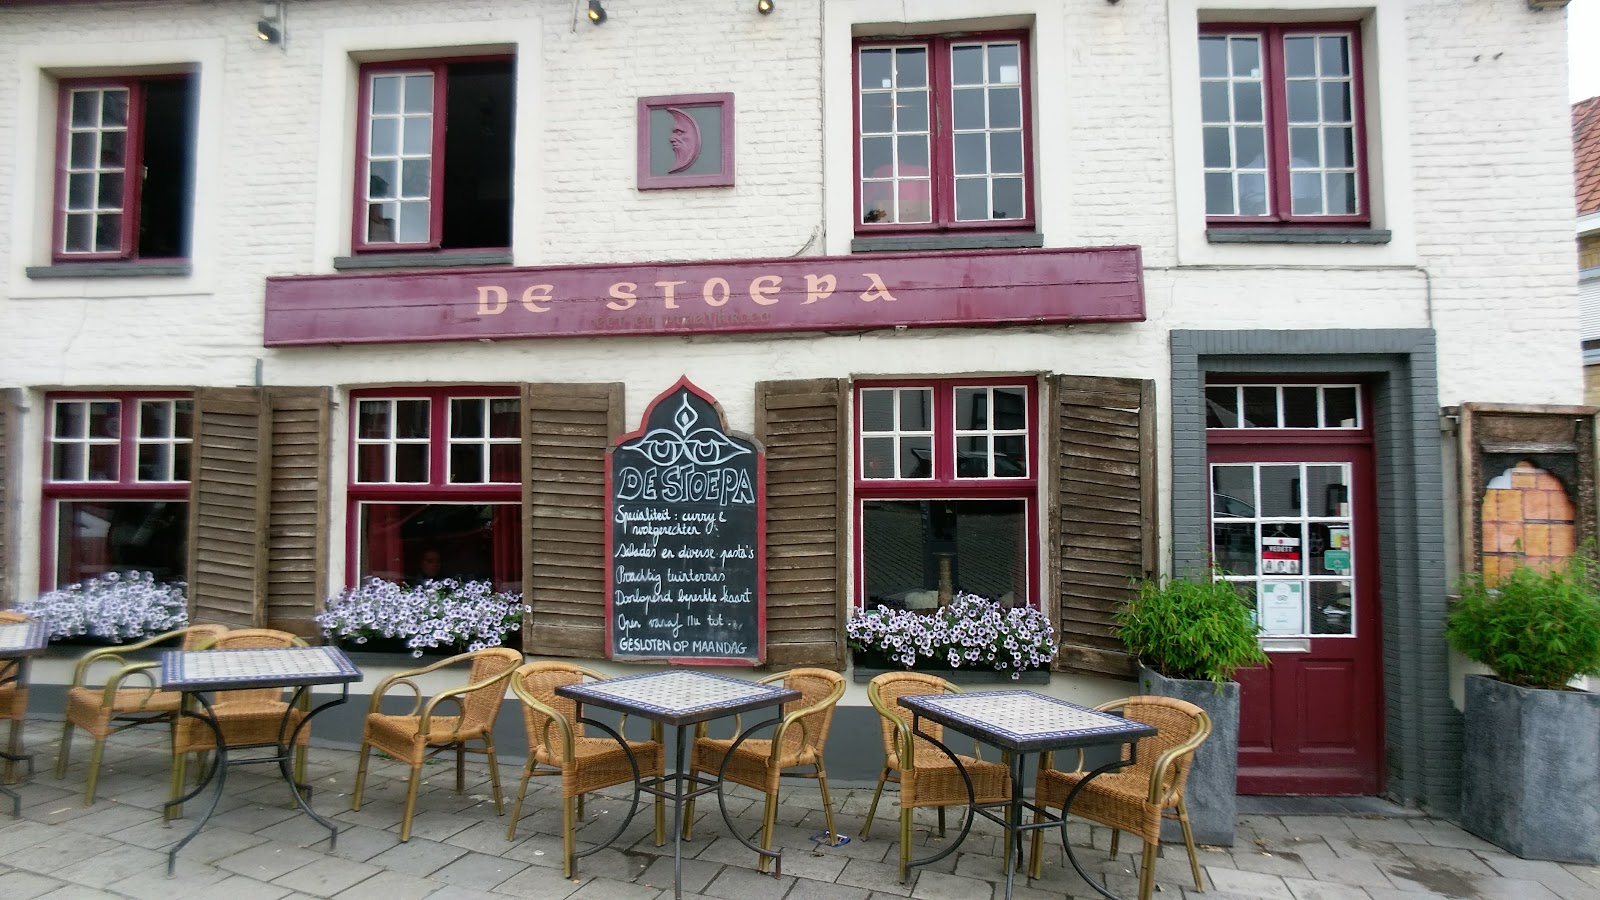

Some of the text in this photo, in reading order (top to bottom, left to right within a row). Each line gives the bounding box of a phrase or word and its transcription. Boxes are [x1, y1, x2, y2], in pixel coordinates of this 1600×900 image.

[476, 273, 897, 315] DE STOEPA
[617, 463, 756, 506] DE STOEPA
[615, 504, 671, 534] Specialiteit
[682, 514, 717, 535] curry
[661, 549, 675, 559] en
[678, 545, 716, 559] diverse
[720, 544, 755, 569] pasta's
[615, 564, 726, 595] Prachtig tuinterras
[720, 585, 752, 604] kaart
[618, 613, 641, 637] Open
[648, 613, 684, 639] vanaf
[619, 637, 748, 655] GESLOTEN OP MAANDAG
